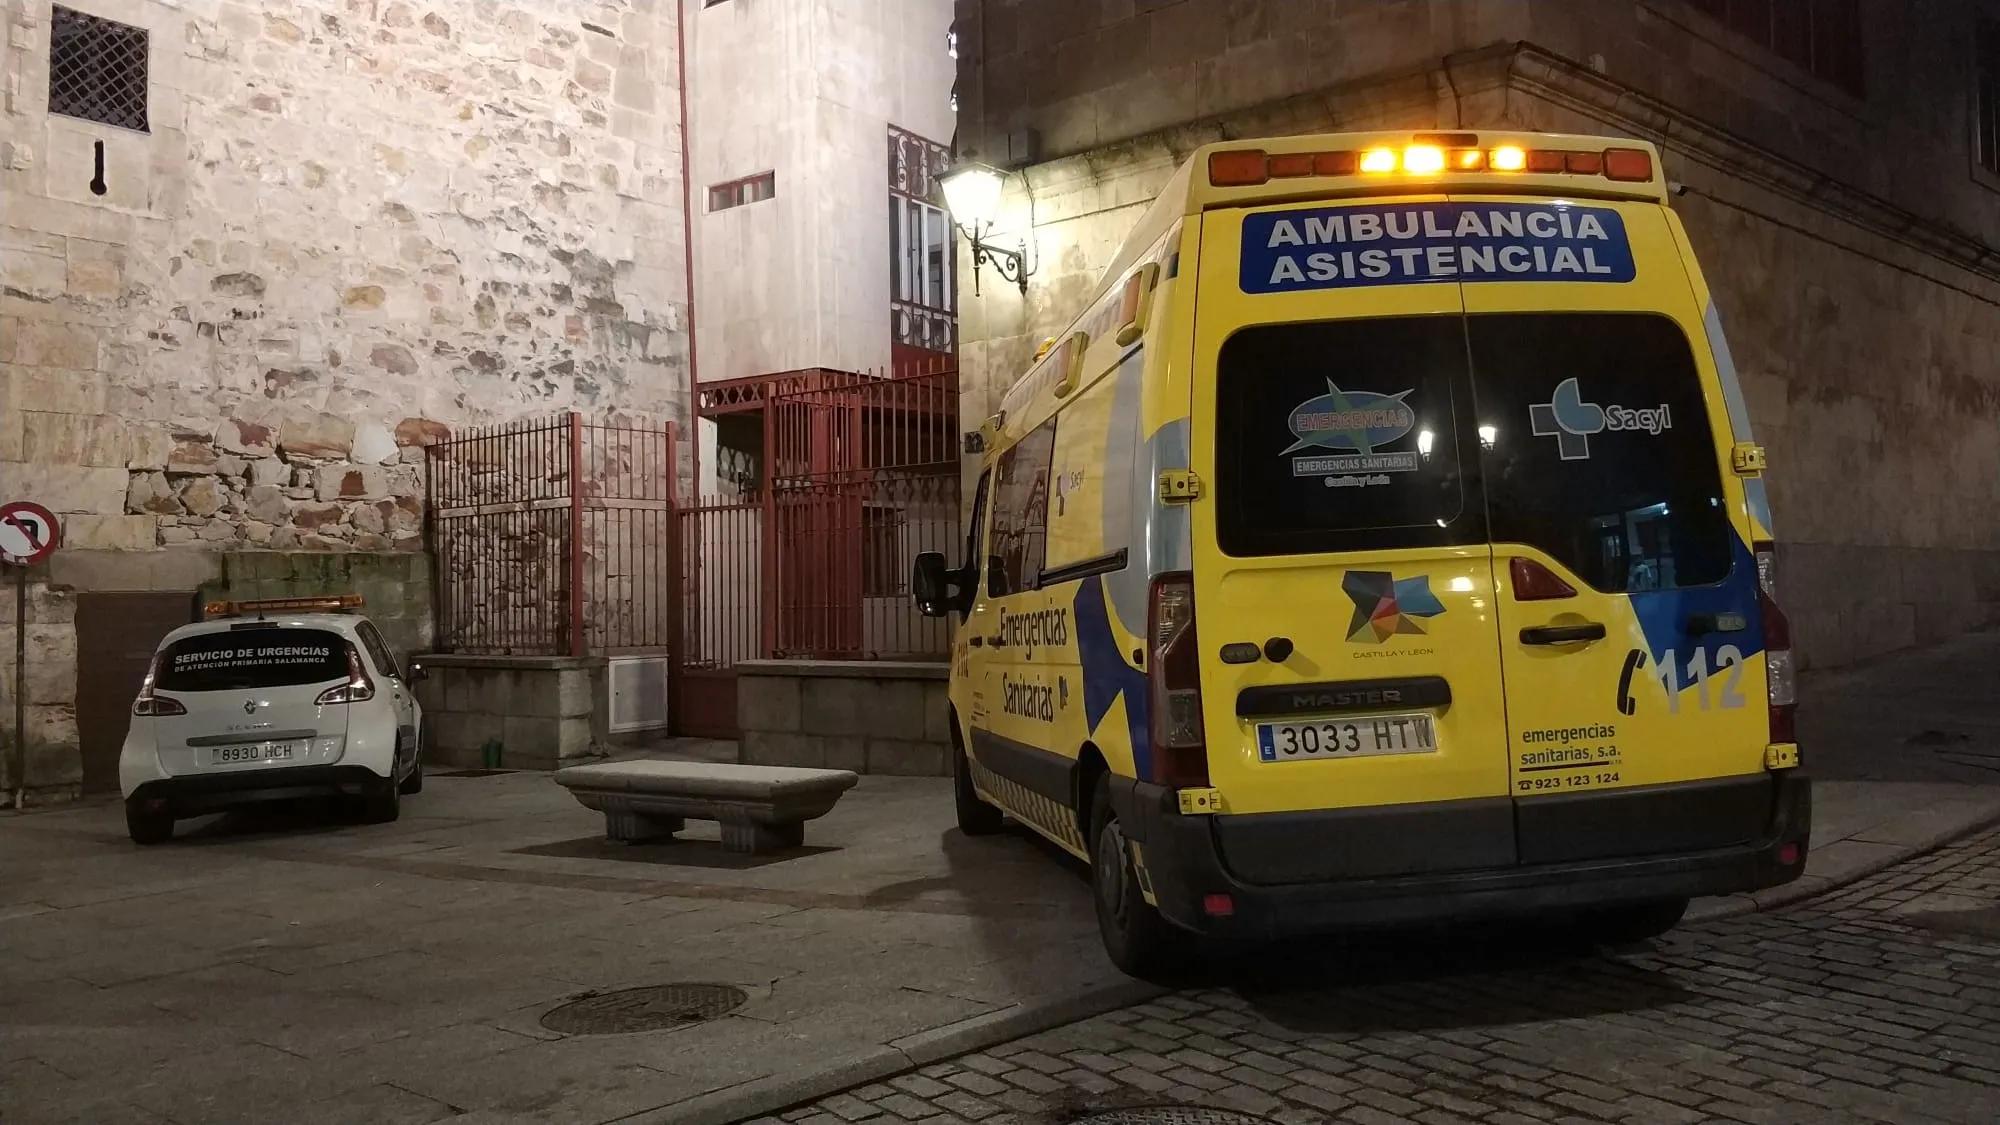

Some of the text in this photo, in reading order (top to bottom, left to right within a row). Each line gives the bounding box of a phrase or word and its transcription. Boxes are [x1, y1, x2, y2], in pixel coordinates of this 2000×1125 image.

[1269, 245, 1612, 284] ASISTENCIAL
[1296, 409, 1409, 431] EMERGENCIAS
[1605, 404, 1672, 435] Sacyl
[1297, 456, 1413, 472] EMERGENCIAS SANITARIAS
[1000, 597, 1067, 661] Emergencias
[175, 646, 330, 664] SERVICIO DE URGENCIAS
[1352, 650, 1398, 659] CASTILLA
[174, 665, 185, 673] DE
[231, 658, 273, 667] PRIMARIA
[1656, 644, 1746, 716] 112
[1002, 671, 1054, 723] Sanitarias
[1293, 690, 1403, 708] MASTER
[1264, 717, 1432, 755] E 3033 HTW
[1522, 723, 1615, 744] emergencias
[222, 745, 293, 761] 8930 HCH
[1520, 745, 1621, 765] sanitarias, s.a.
[1535, 772, 1620, 789] 923 123 124
